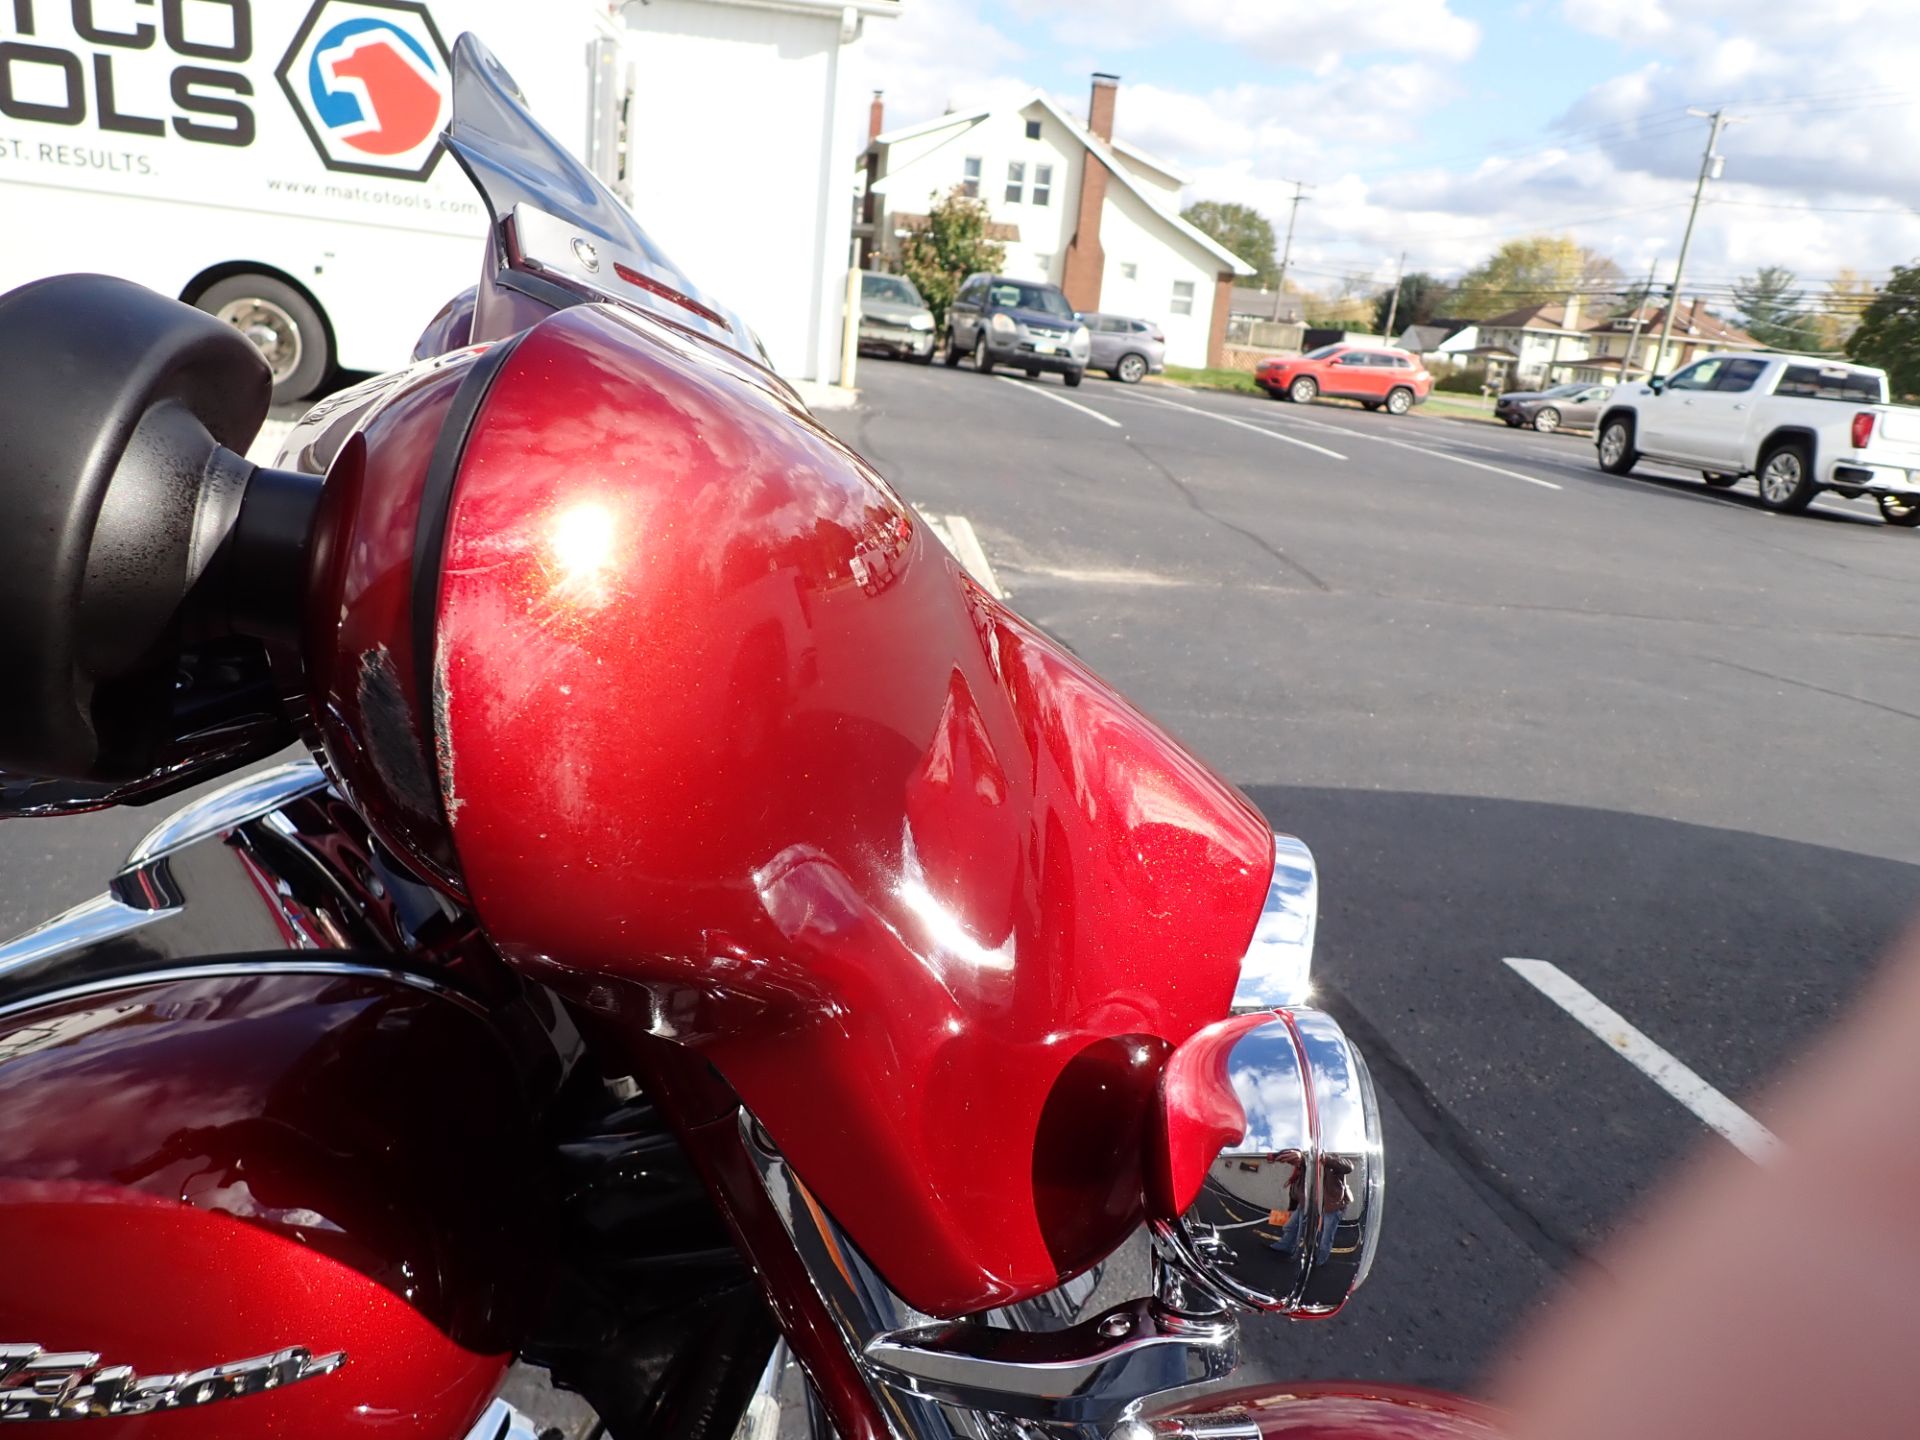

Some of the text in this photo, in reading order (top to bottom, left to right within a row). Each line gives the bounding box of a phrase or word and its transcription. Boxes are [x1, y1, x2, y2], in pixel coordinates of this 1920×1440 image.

[0, 41, 256, 147] OLS
[39, 143, 159, 176] RESULTS.
[266, 178, 478, 215] www.matcotools.com
